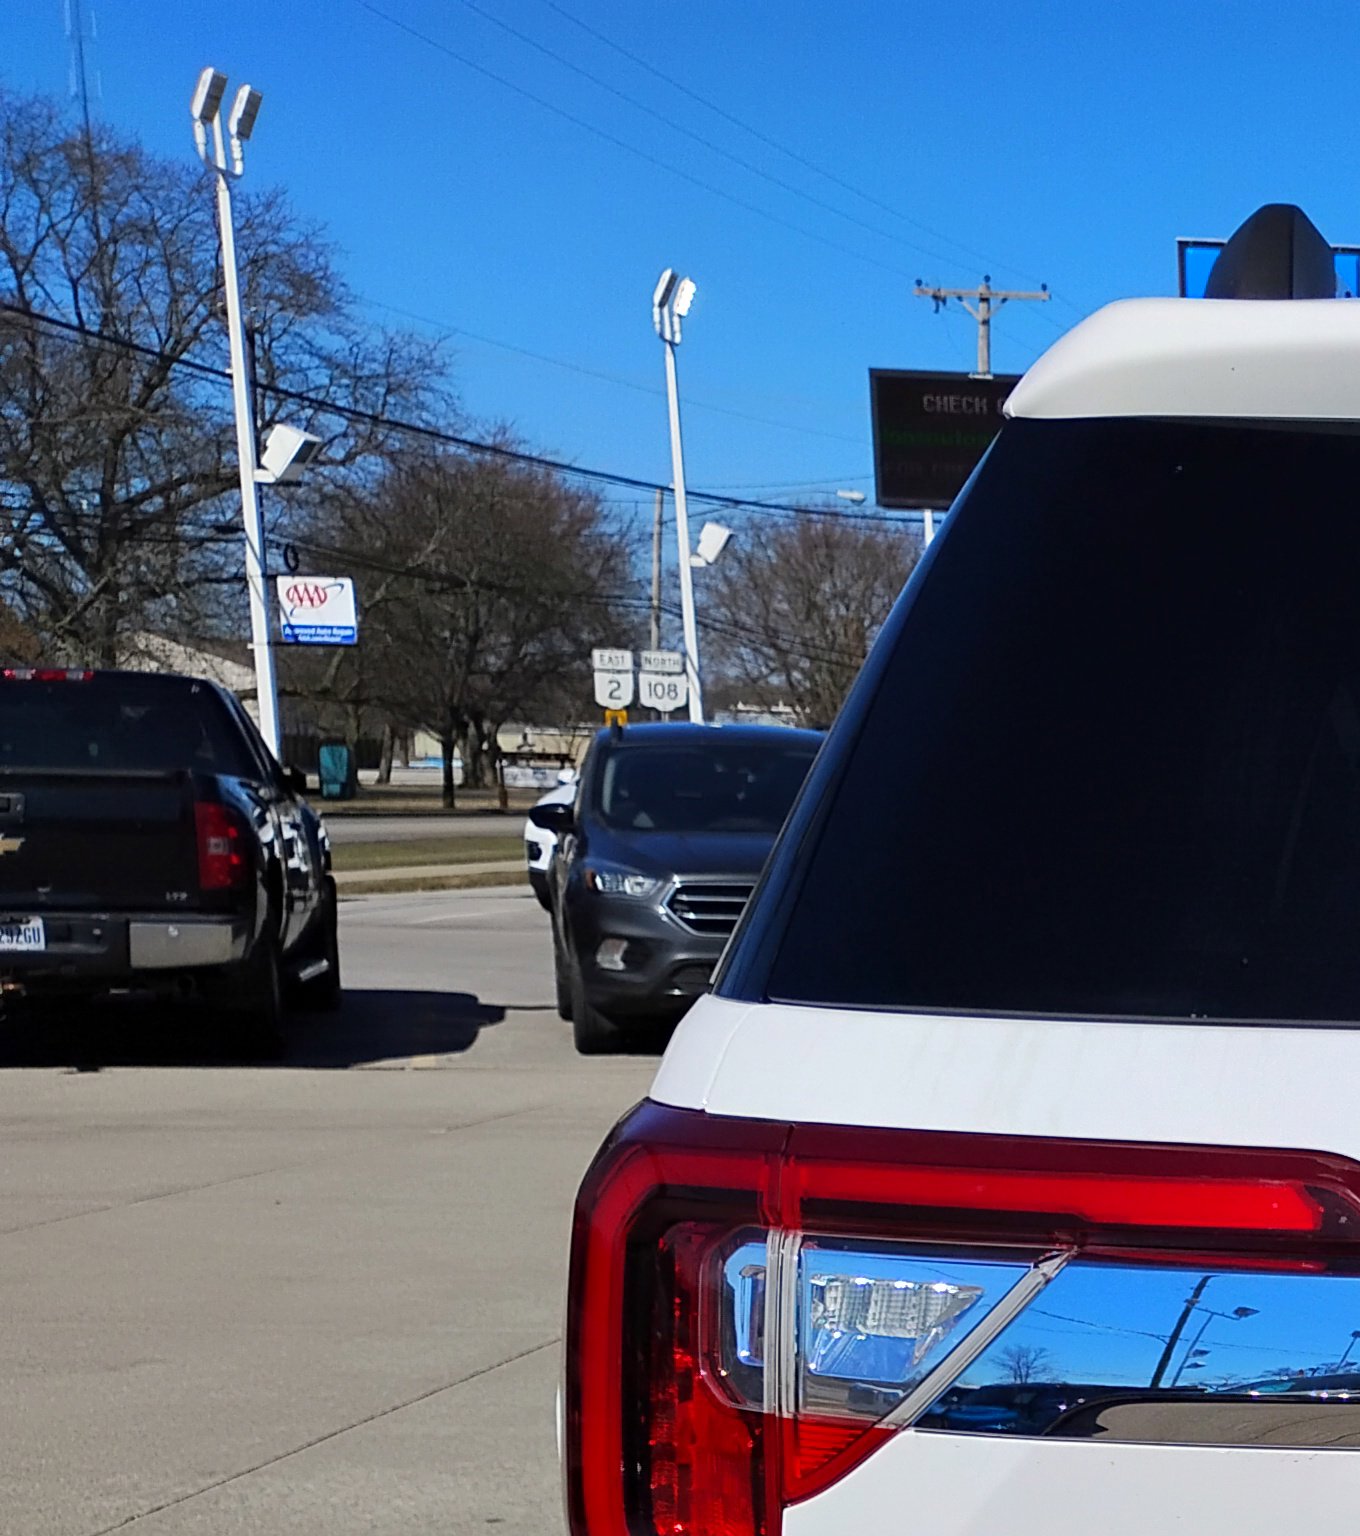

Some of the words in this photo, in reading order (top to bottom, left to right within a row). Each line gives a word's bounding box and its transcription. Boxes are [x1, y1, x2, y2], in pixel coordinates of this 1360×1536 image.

[286, 583, 328, 608] AAA
[600, 654, 625, 665] EAST
[644, 656, 680, 666] NORTH
[608, 680, 622, 700] 2
[648, 681, 679, 700] 108
